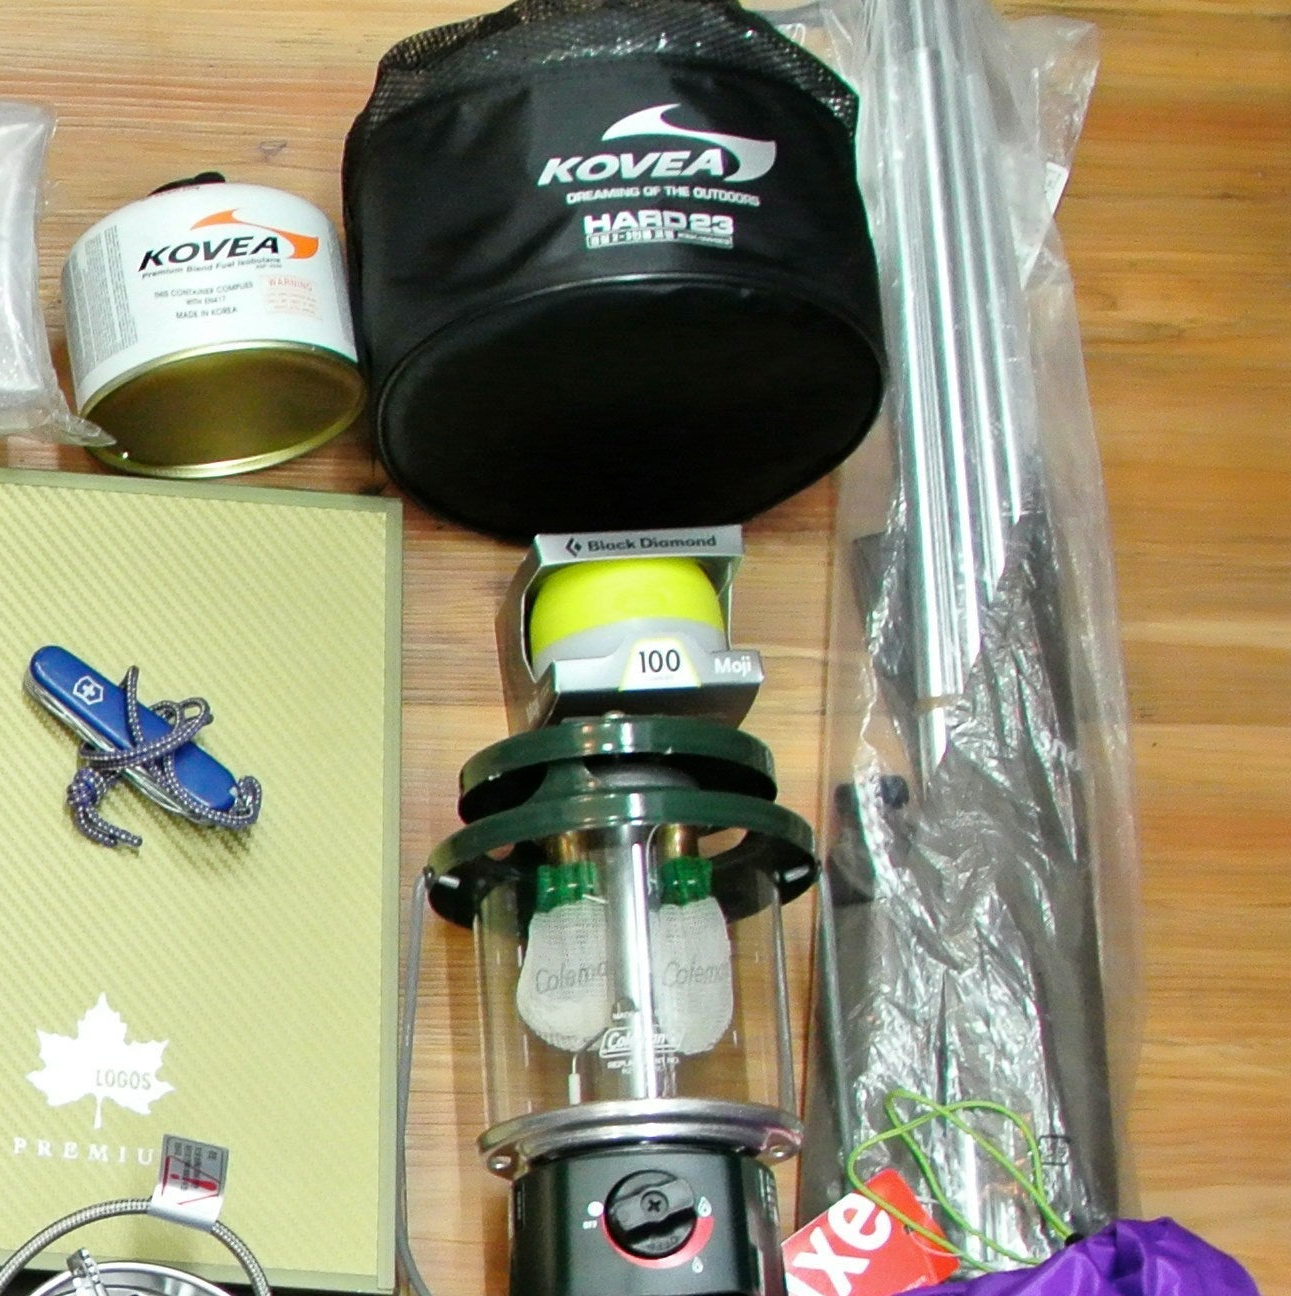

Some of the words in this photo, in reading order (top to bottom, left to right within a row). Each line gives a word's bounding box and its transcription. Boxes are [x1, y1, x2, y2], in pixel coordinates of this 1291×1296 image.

[537, 148, 725, 187] KOVEA
[566, 187, 640, 205] DREAMING
[643, 186, 661, 197] OF
[664, 186, 690, 198] THE
[693, 187, 761, 207] OUTDOORS
[138, 236, 280, 272] KOVEA
[142, 266, 184, 279] Premium
[186, 263, 213, 273] Blend
[215, 261, 235, 270] Fuel
[171, 287, 214, 297] CONTAINER
[269, 278, 313, 292] WARNING
[176, 310, 198, 319] MADE
[200, 309, 209, 318] IN
[211, 306, 238, 316] KOREA
[587, 537, 636, 552] Black
[639, 535, 717, 549] Diamond
[639, 648, 681, 673] 100
[714, 655, 752, 677] Moji
[96, 1069, 152, 1090] LOGOS
[11, 1136, 154, 1166] PREMIU
